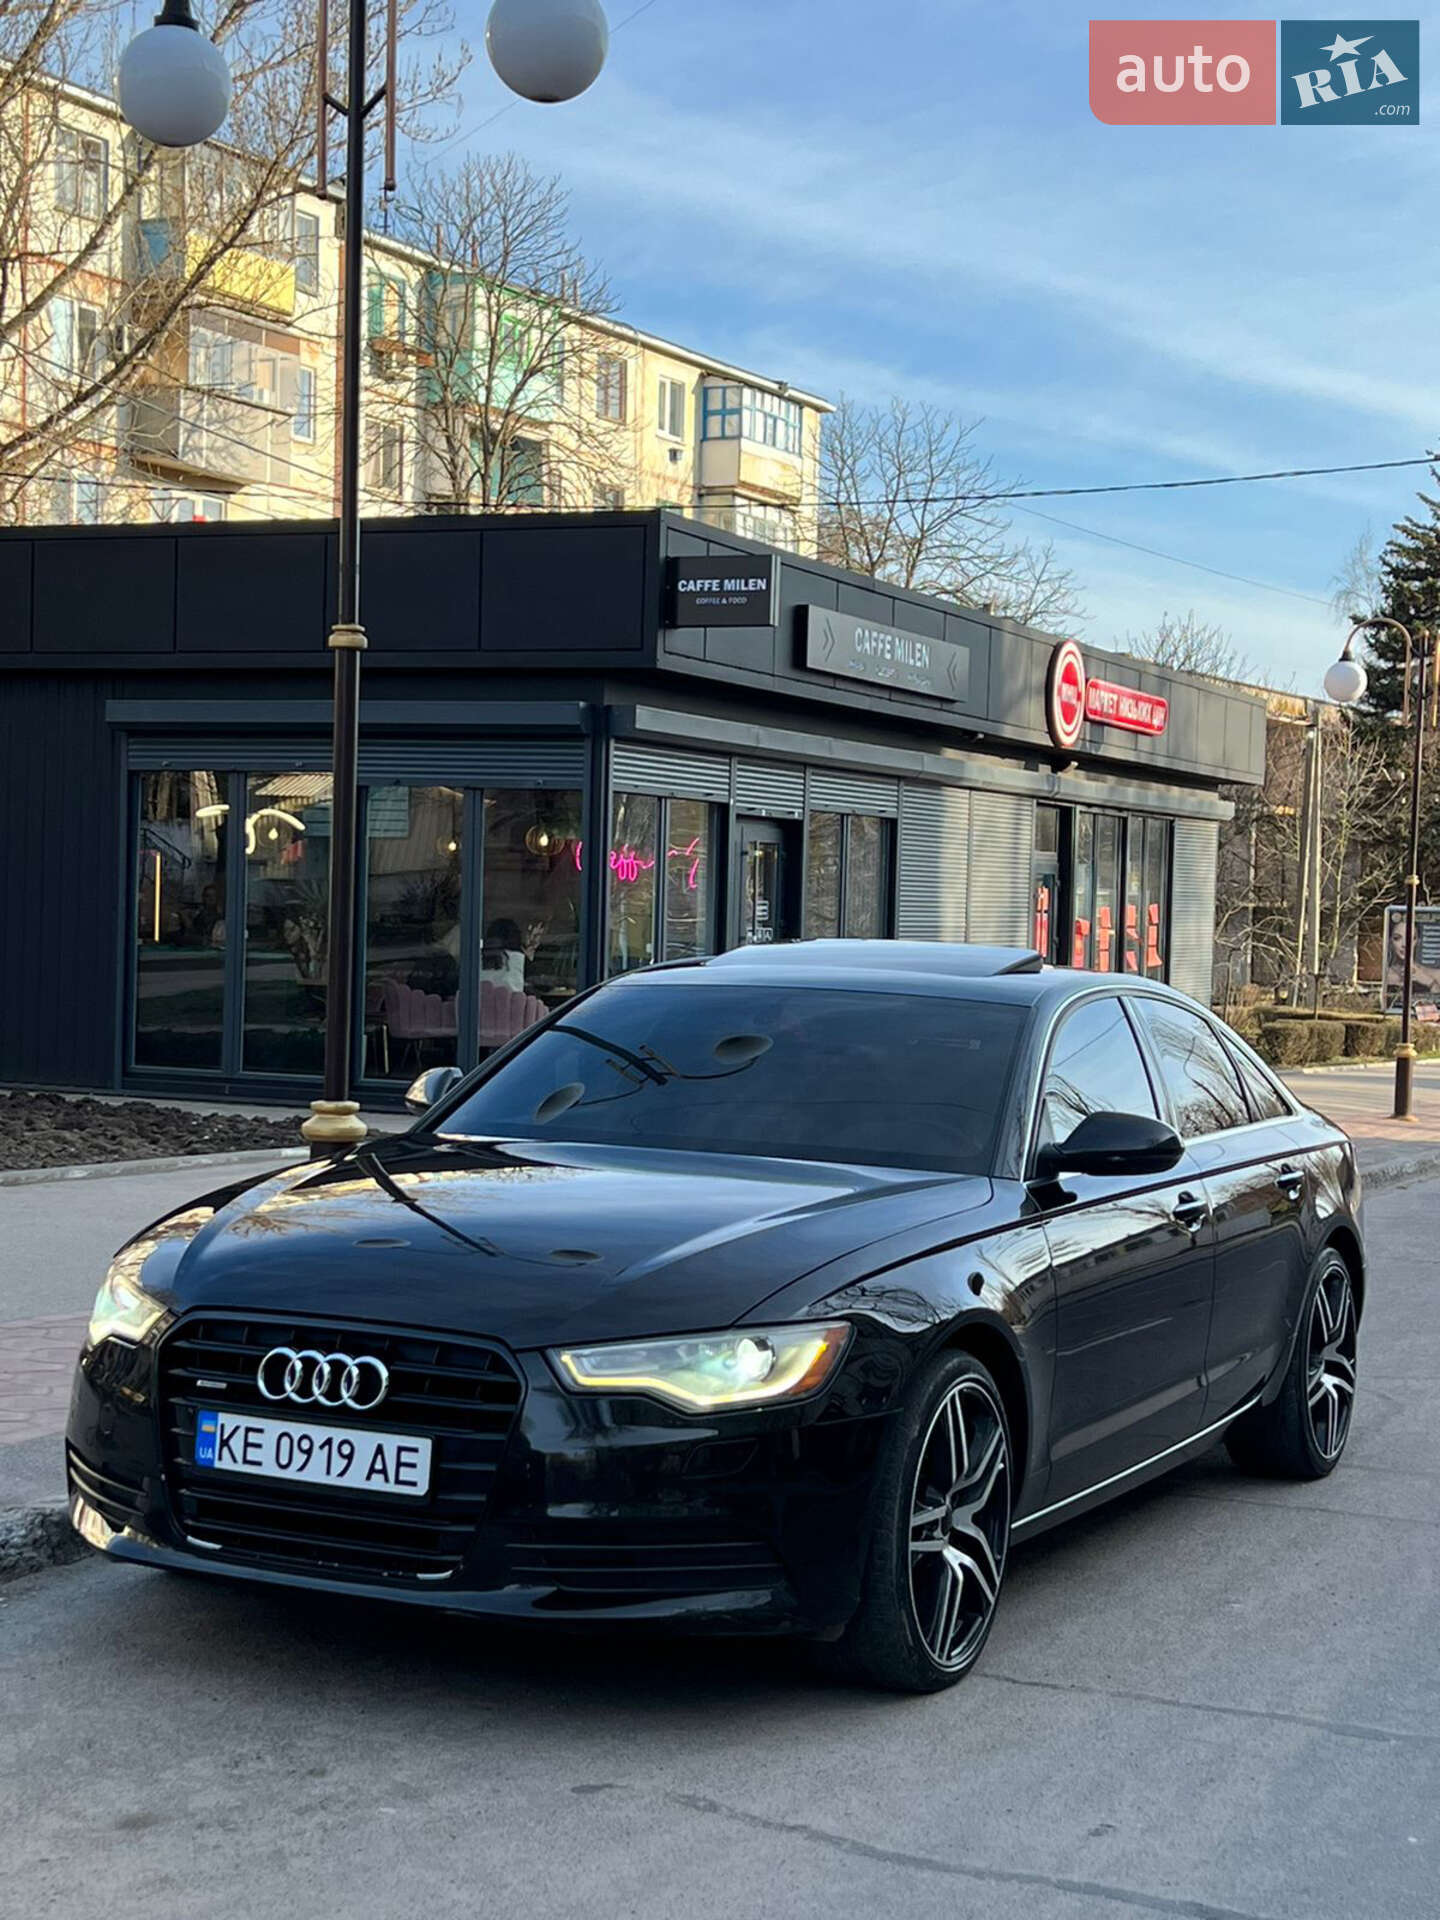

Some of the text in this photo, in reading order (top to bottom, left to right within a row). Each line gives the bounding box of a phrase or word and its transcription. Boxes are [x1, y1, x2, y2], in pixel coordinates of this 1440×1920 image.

[678, 578, 766, 592] CAFFE MILEN
[855, 627, 892, 660] CAFFE
[895, 636, 930, 669] MILEN
[199, 1447, 213, 1459] UA
[217, 1422, 420, 1487] KE 0919 AE
